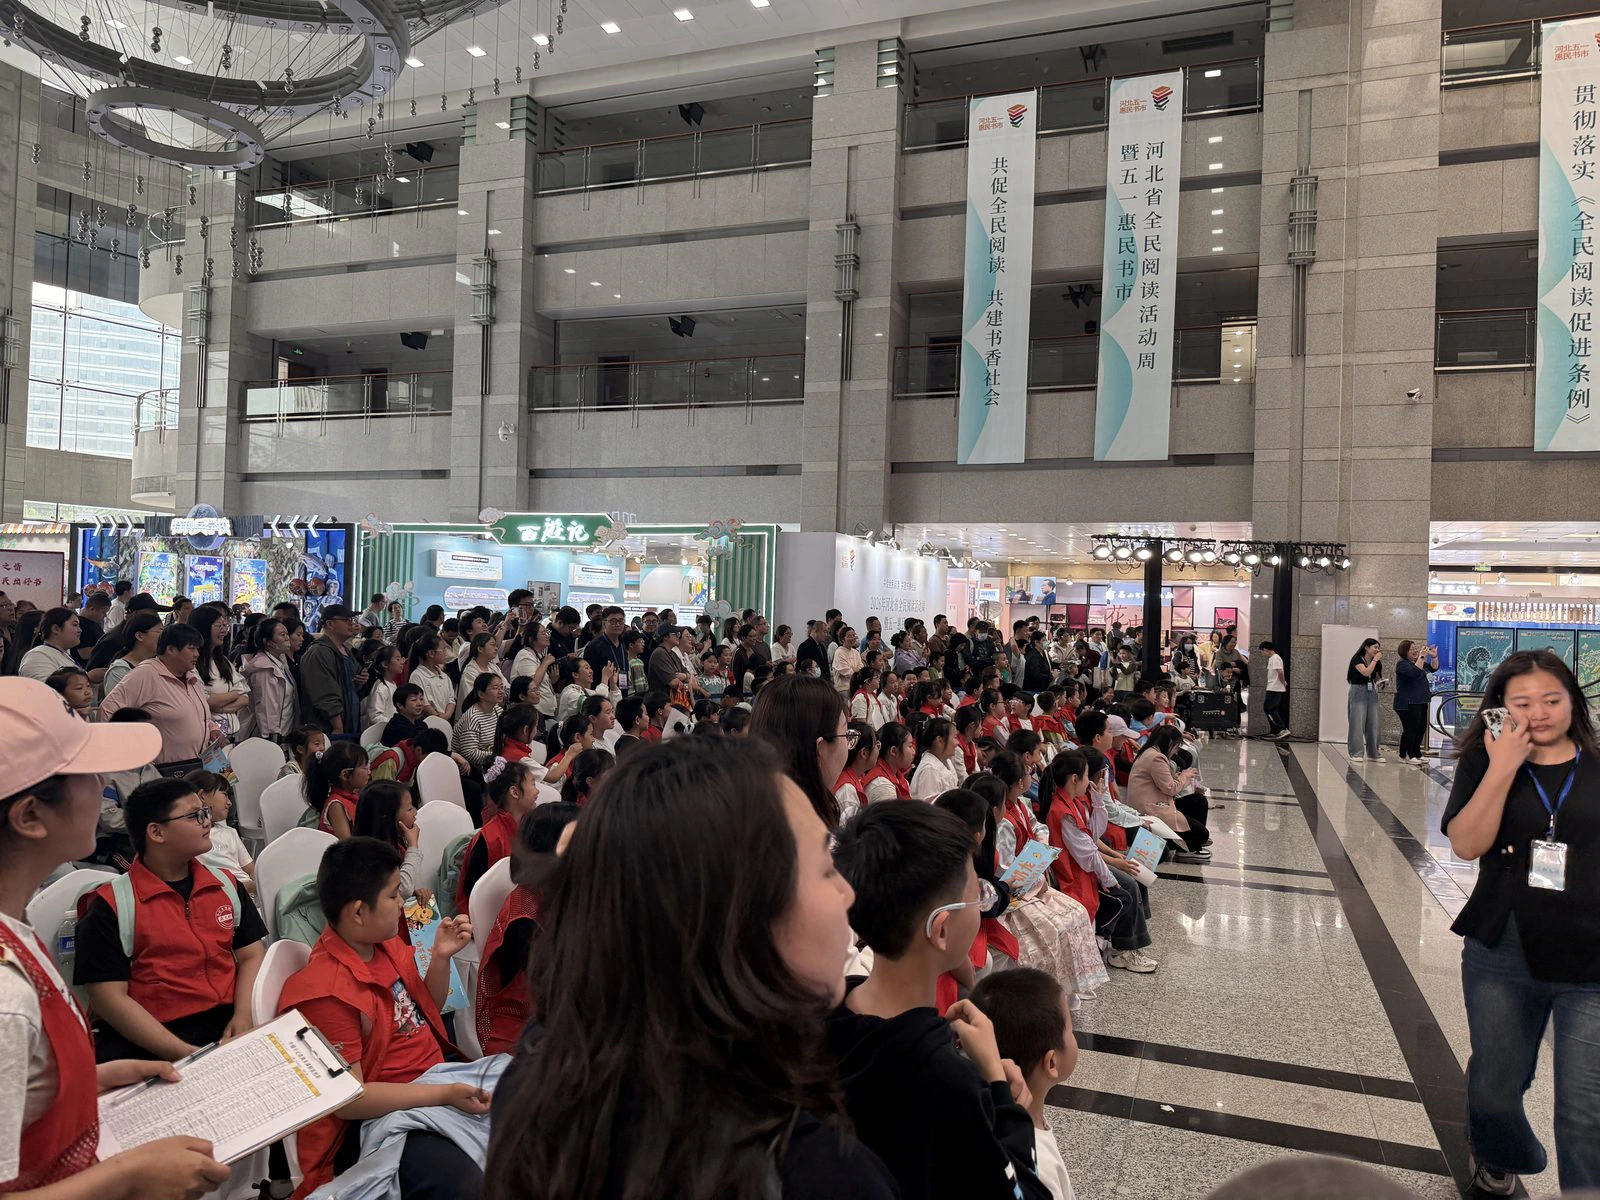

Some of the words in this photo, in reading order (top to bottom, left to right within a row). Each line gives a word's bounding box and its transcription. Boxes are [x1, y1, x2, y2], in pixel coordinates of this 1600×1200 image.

[988, 156, 1009, 274] 共促全民阅读
[1115, 144, 1140, 302] 暨五一惠民书市
[1136, 140, 1165, 370] 河北省全民阅读活动周
[1566, 84, 1597, 425] 贯彻落实《全民阅读促进条例》
[983, 289, 1004, 406] 共建书香社会
